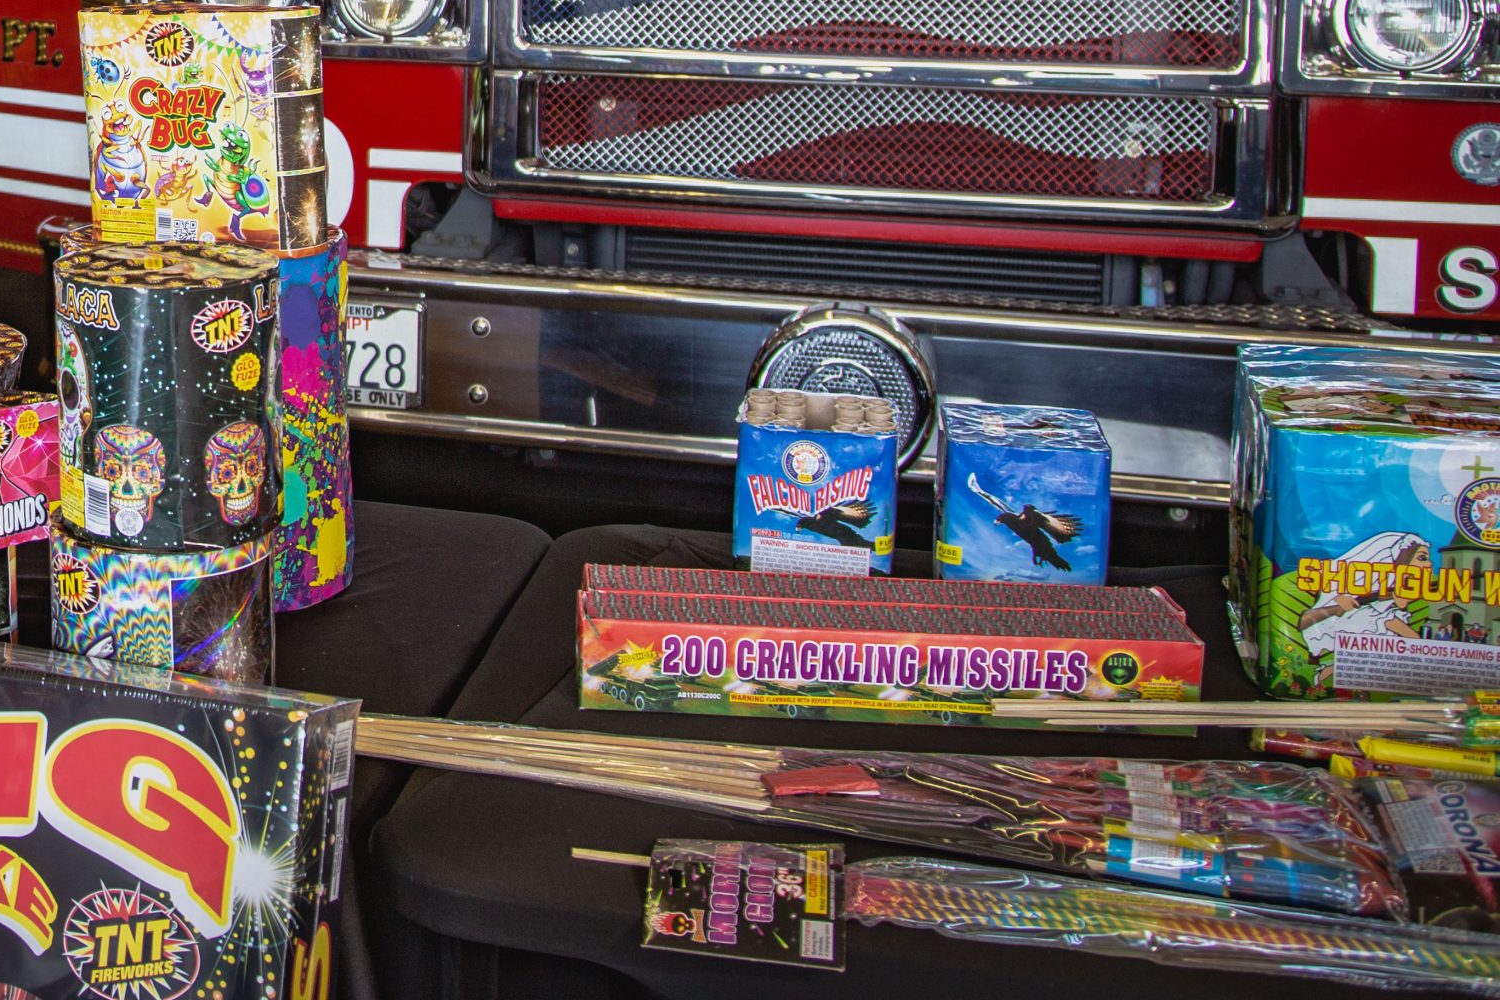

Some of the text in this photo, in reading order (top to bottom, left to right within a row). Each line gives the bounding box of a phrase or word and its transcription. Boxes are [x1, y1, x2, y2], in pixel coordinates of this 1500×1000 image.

[153, 31, 184, 57] TNT
[128, 77, 225, 121] CRAZY
[148, 118, 215, 152] BUG
[204, 318, 241, 343] TNT
[235, 370, 260, 381] FUZE
[369, 389, 405, 406] ONLY
[17, 423, 39, 433] FUZE
[747, 466, 874, 517] FALCON RISING
[759, 539, 868, 557] WARNING SHOOTS FLAMING BALLS
[938, 546, 959, 557] FUSE
[57, 571, 85, 596] TNT
[1297, 556, 1472, 604] SHOTGUN
[662, 634, 727, 678] 200
[736, 638, 920, 688] CRACKLING
[926, 645, 1089, 694] MISSILES
[1108, 657, 1133, 668] ALIEN
[1450, 647, 1494, 662] FLAMING
[731, 694, 765, 703] WARNING
[765, 696, 797, 704] FLAMMABLE
[893, 702, 923, 710] CAREFULLY
[923, 703, 939, 711] READ
[1434, 779, 1500, 877] CORONA
[94, 918, 171, 968] TNT
[90, 960, 176, 985] FIREWORKS
